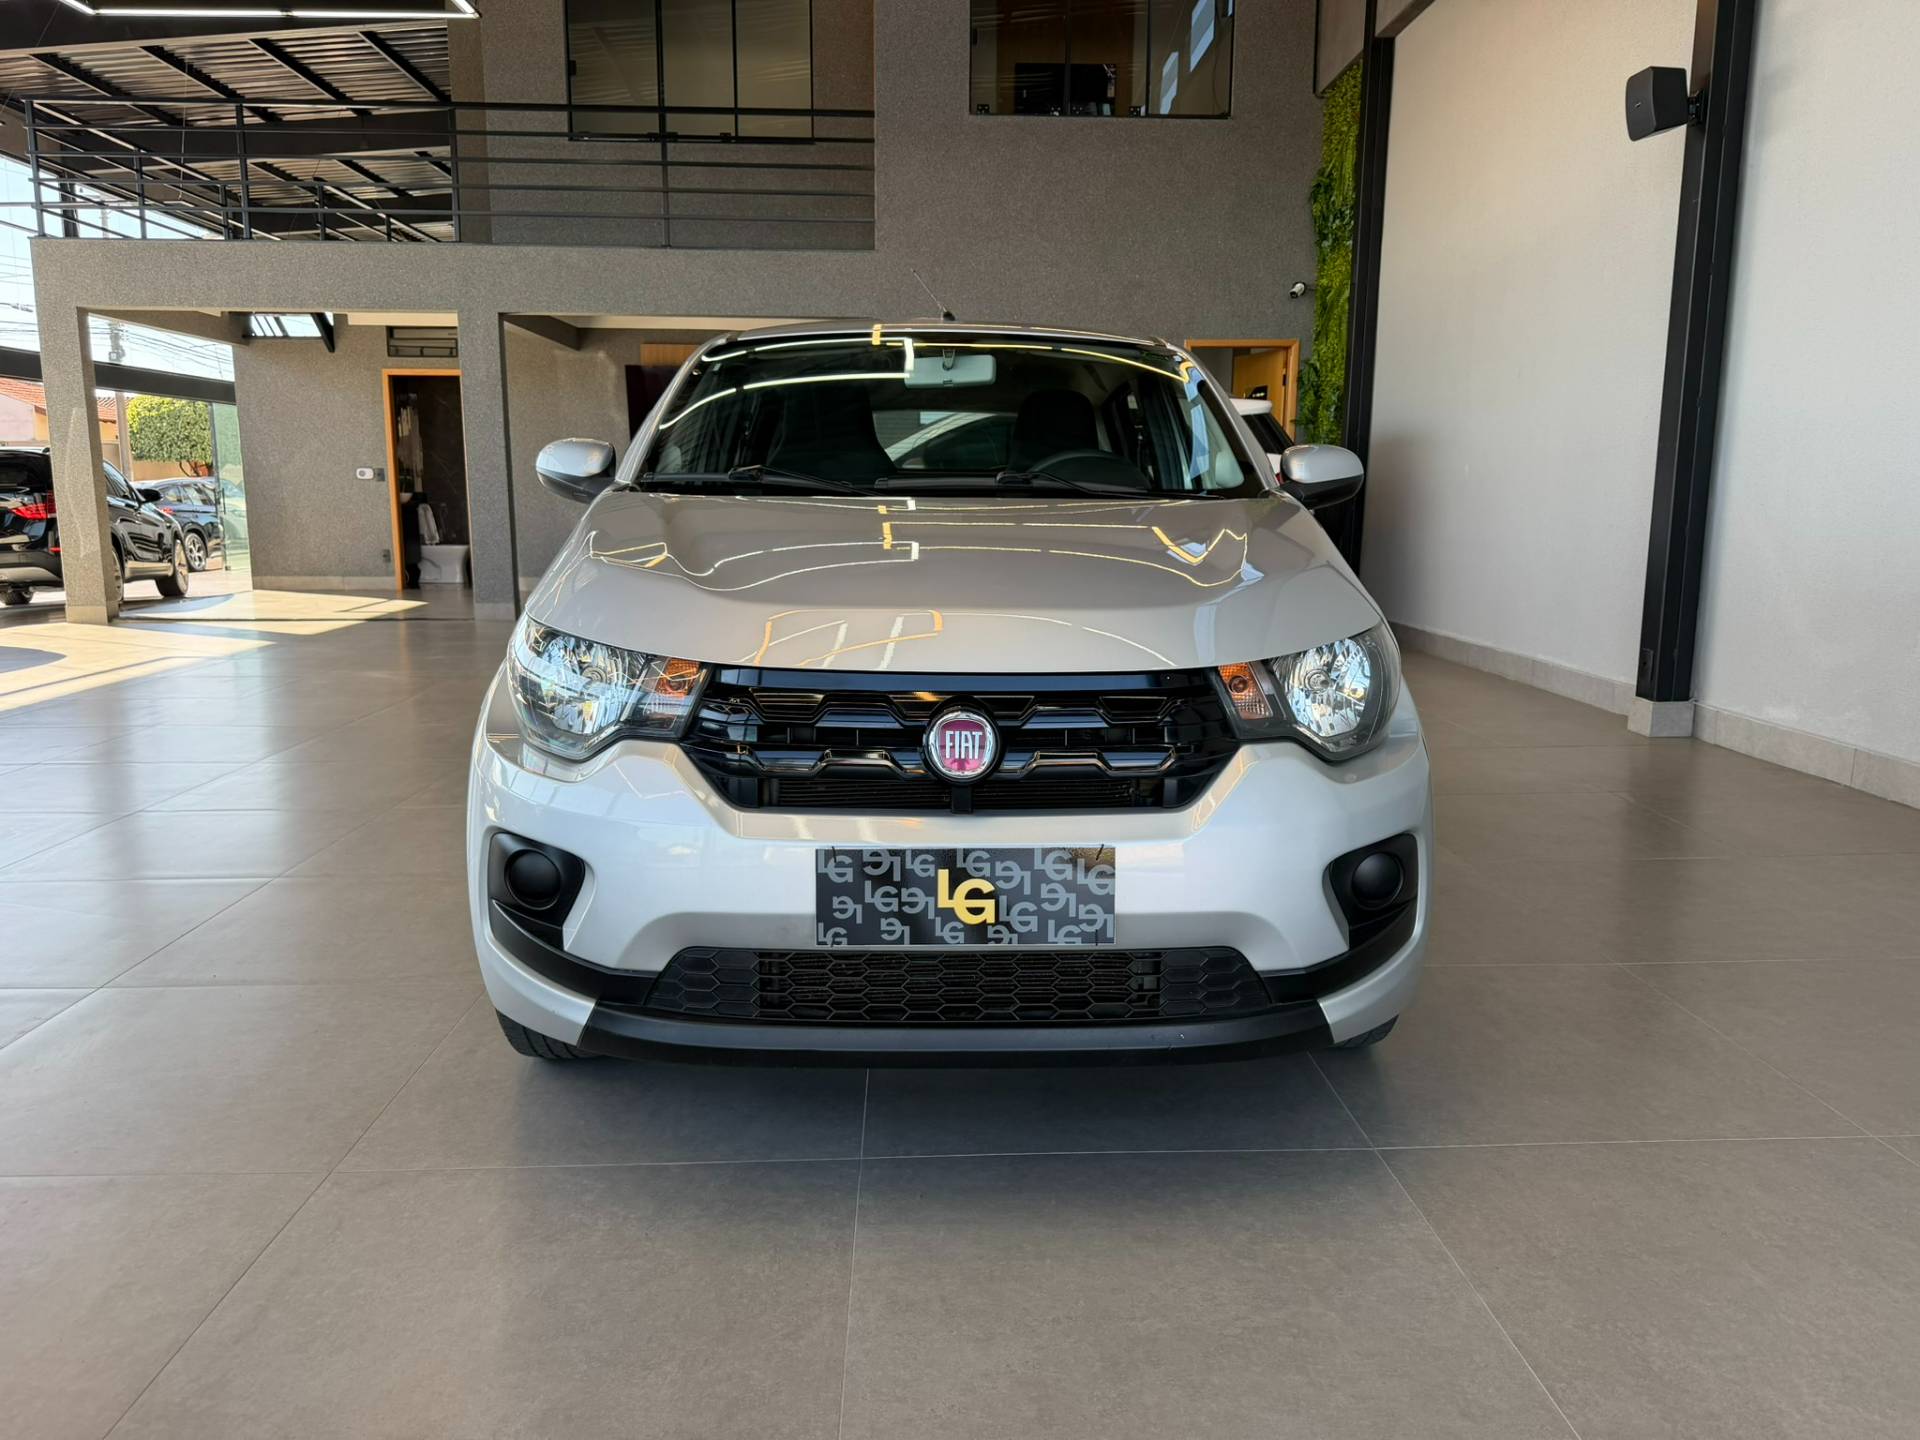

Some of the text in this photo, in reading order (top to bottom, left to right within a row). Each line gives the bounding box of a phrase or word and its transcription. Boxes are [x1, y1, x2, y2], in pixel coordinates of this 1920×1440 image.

[945, 730, 983, 760] FIAT
[956, 848, 991, 878] LG
[1033, 848, 1073, 880] LG
[1077, 858, 1115, 895] LG
[864, 880, 899, 913] LG
[938, 869, 995, 925] LG
[999, 895, 1038, 933] LG
[935, 917, 965, 944] LG
